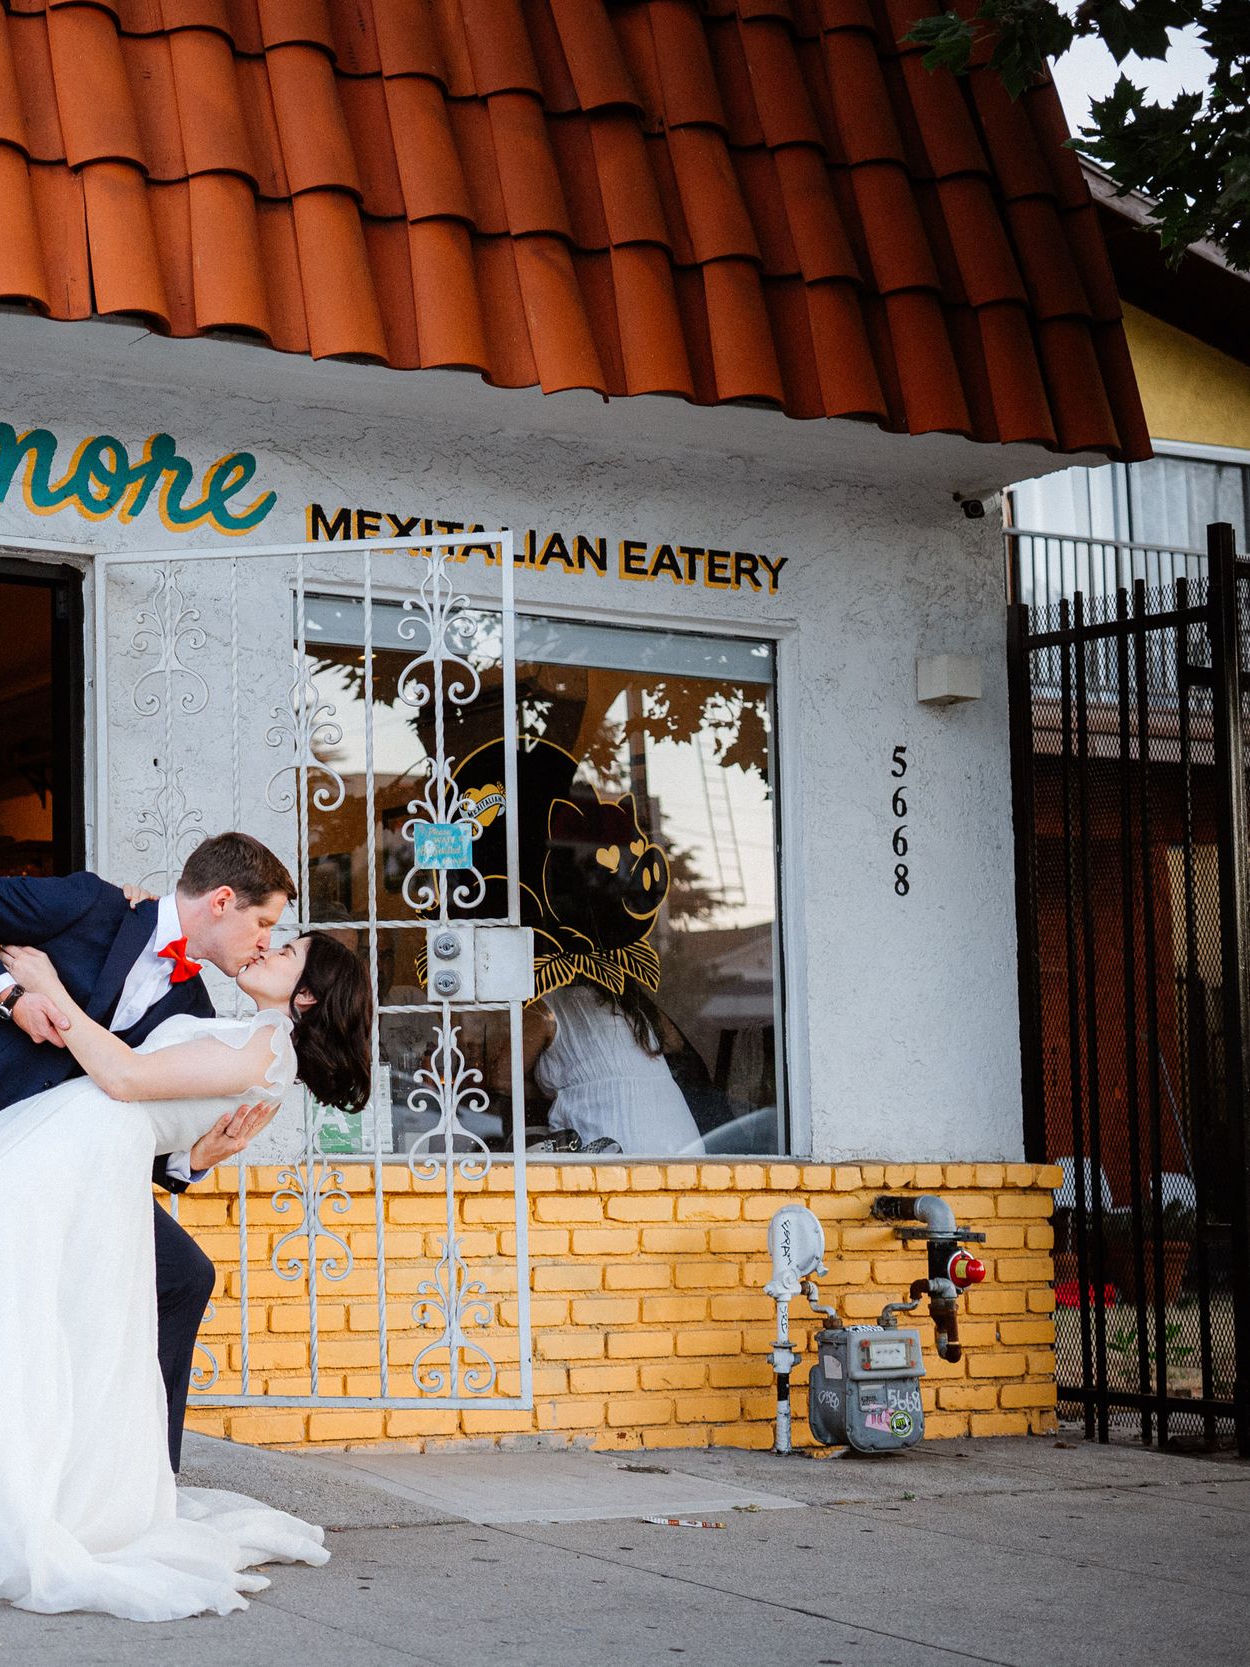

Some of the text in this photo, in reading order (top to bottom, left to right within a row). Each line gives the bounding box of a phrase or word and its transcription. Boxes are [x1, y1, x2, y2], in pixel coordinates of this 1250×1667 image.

[619, 539, 788, 595] EATERY
[891, 745, 910, 896] 5668
[887, 1388, 921, 1412] 5668
